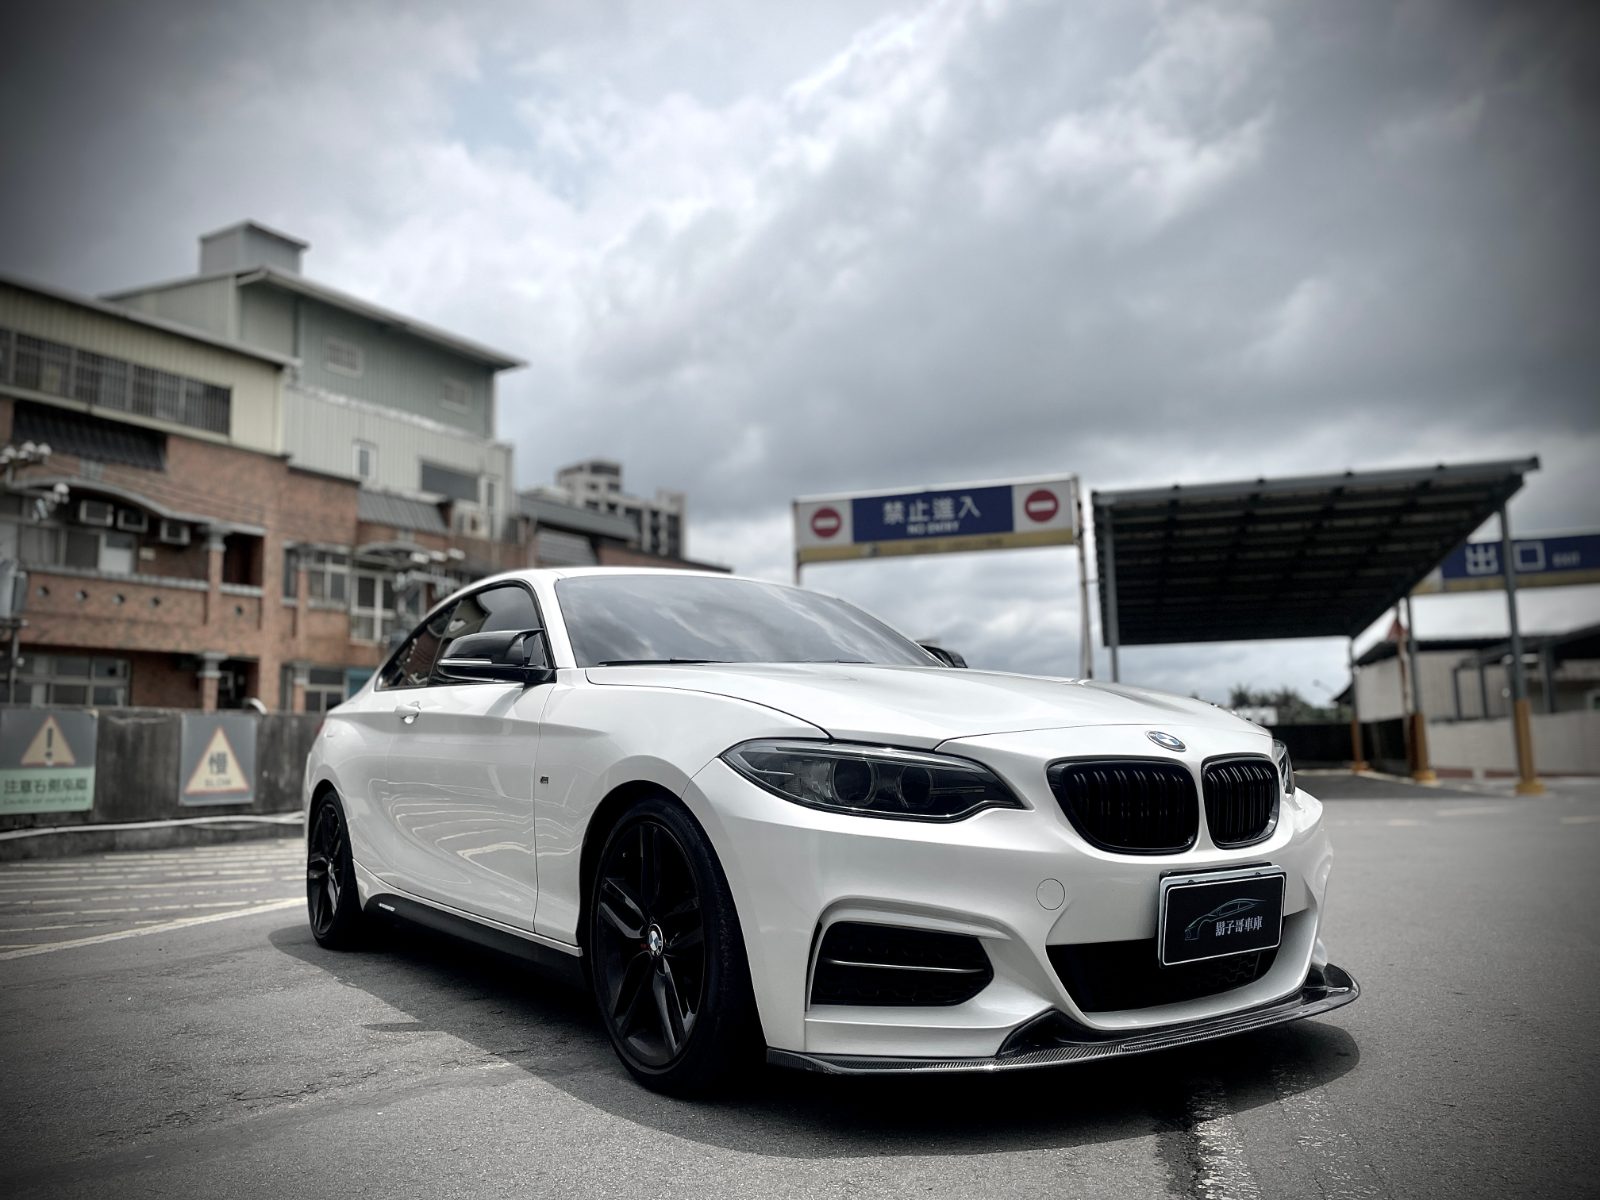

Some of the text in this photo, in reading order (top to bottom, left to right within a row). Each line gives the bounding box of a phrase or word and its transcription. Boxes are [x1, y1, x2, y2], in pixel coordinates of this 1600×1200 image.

[883, 495, 982, 525] 禁止進入
[208, 752, 228, 775] 慢
